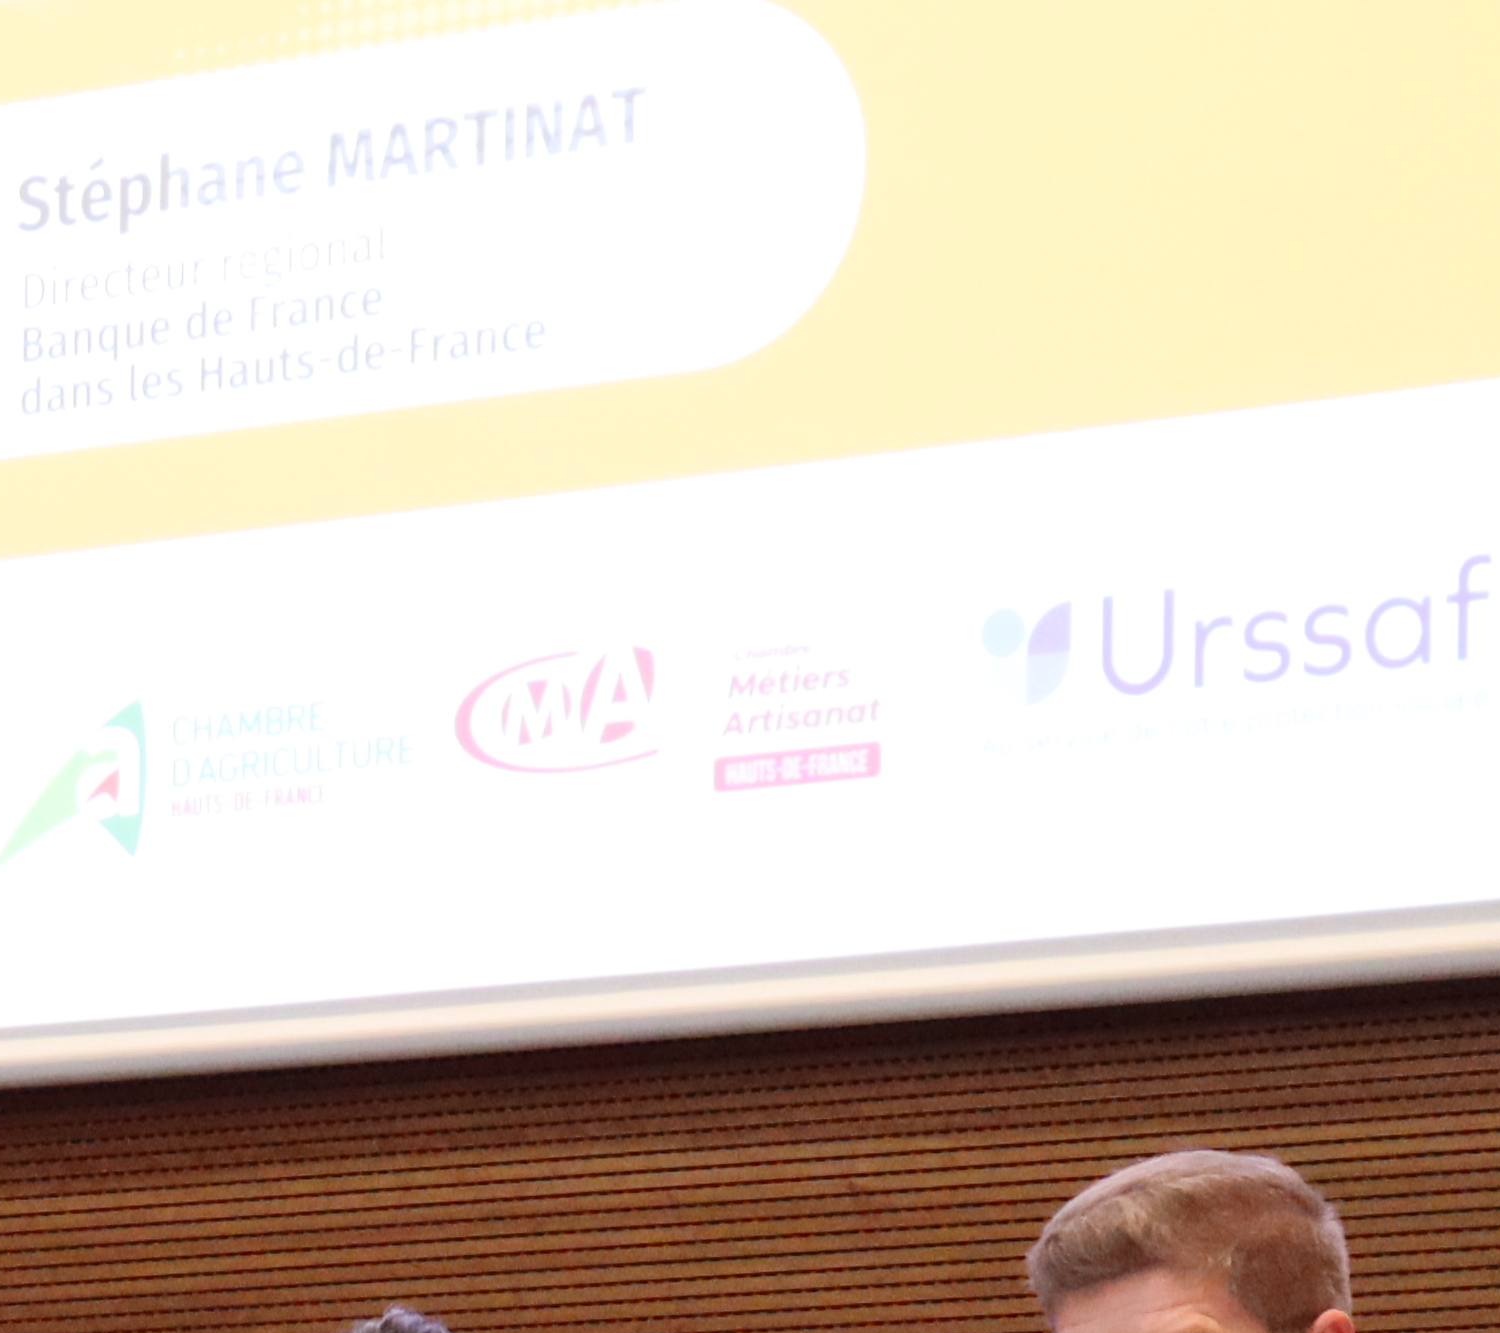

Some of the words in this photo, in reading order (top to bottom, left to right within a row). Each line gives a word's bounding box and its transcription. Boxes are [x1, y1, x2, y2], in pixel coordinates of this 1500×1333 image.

[16, 150, 306, 235] Stéphane
[325, 86, 647, 188] MARTINAT
[22, 256, 205, 310] Directeur
[21, 315, 170, 364] Banque
[185, 299, 234, 343] de
[249, 287, 384, 332] France
[20, 375, 115, 416] dans
[128, 362, 185, 403] les
[199, 319, 547, 393] Hauts-de-France
[1100, 552, 1493, 698] Urssaf
[728, 665, 851, 700] Métiers
[171, 701, 325, 747] CHAMBRE
[721, 698, 882, 738] Artisanat
[724, 748, 869, 786] HAUTS-DE-FRANCE
